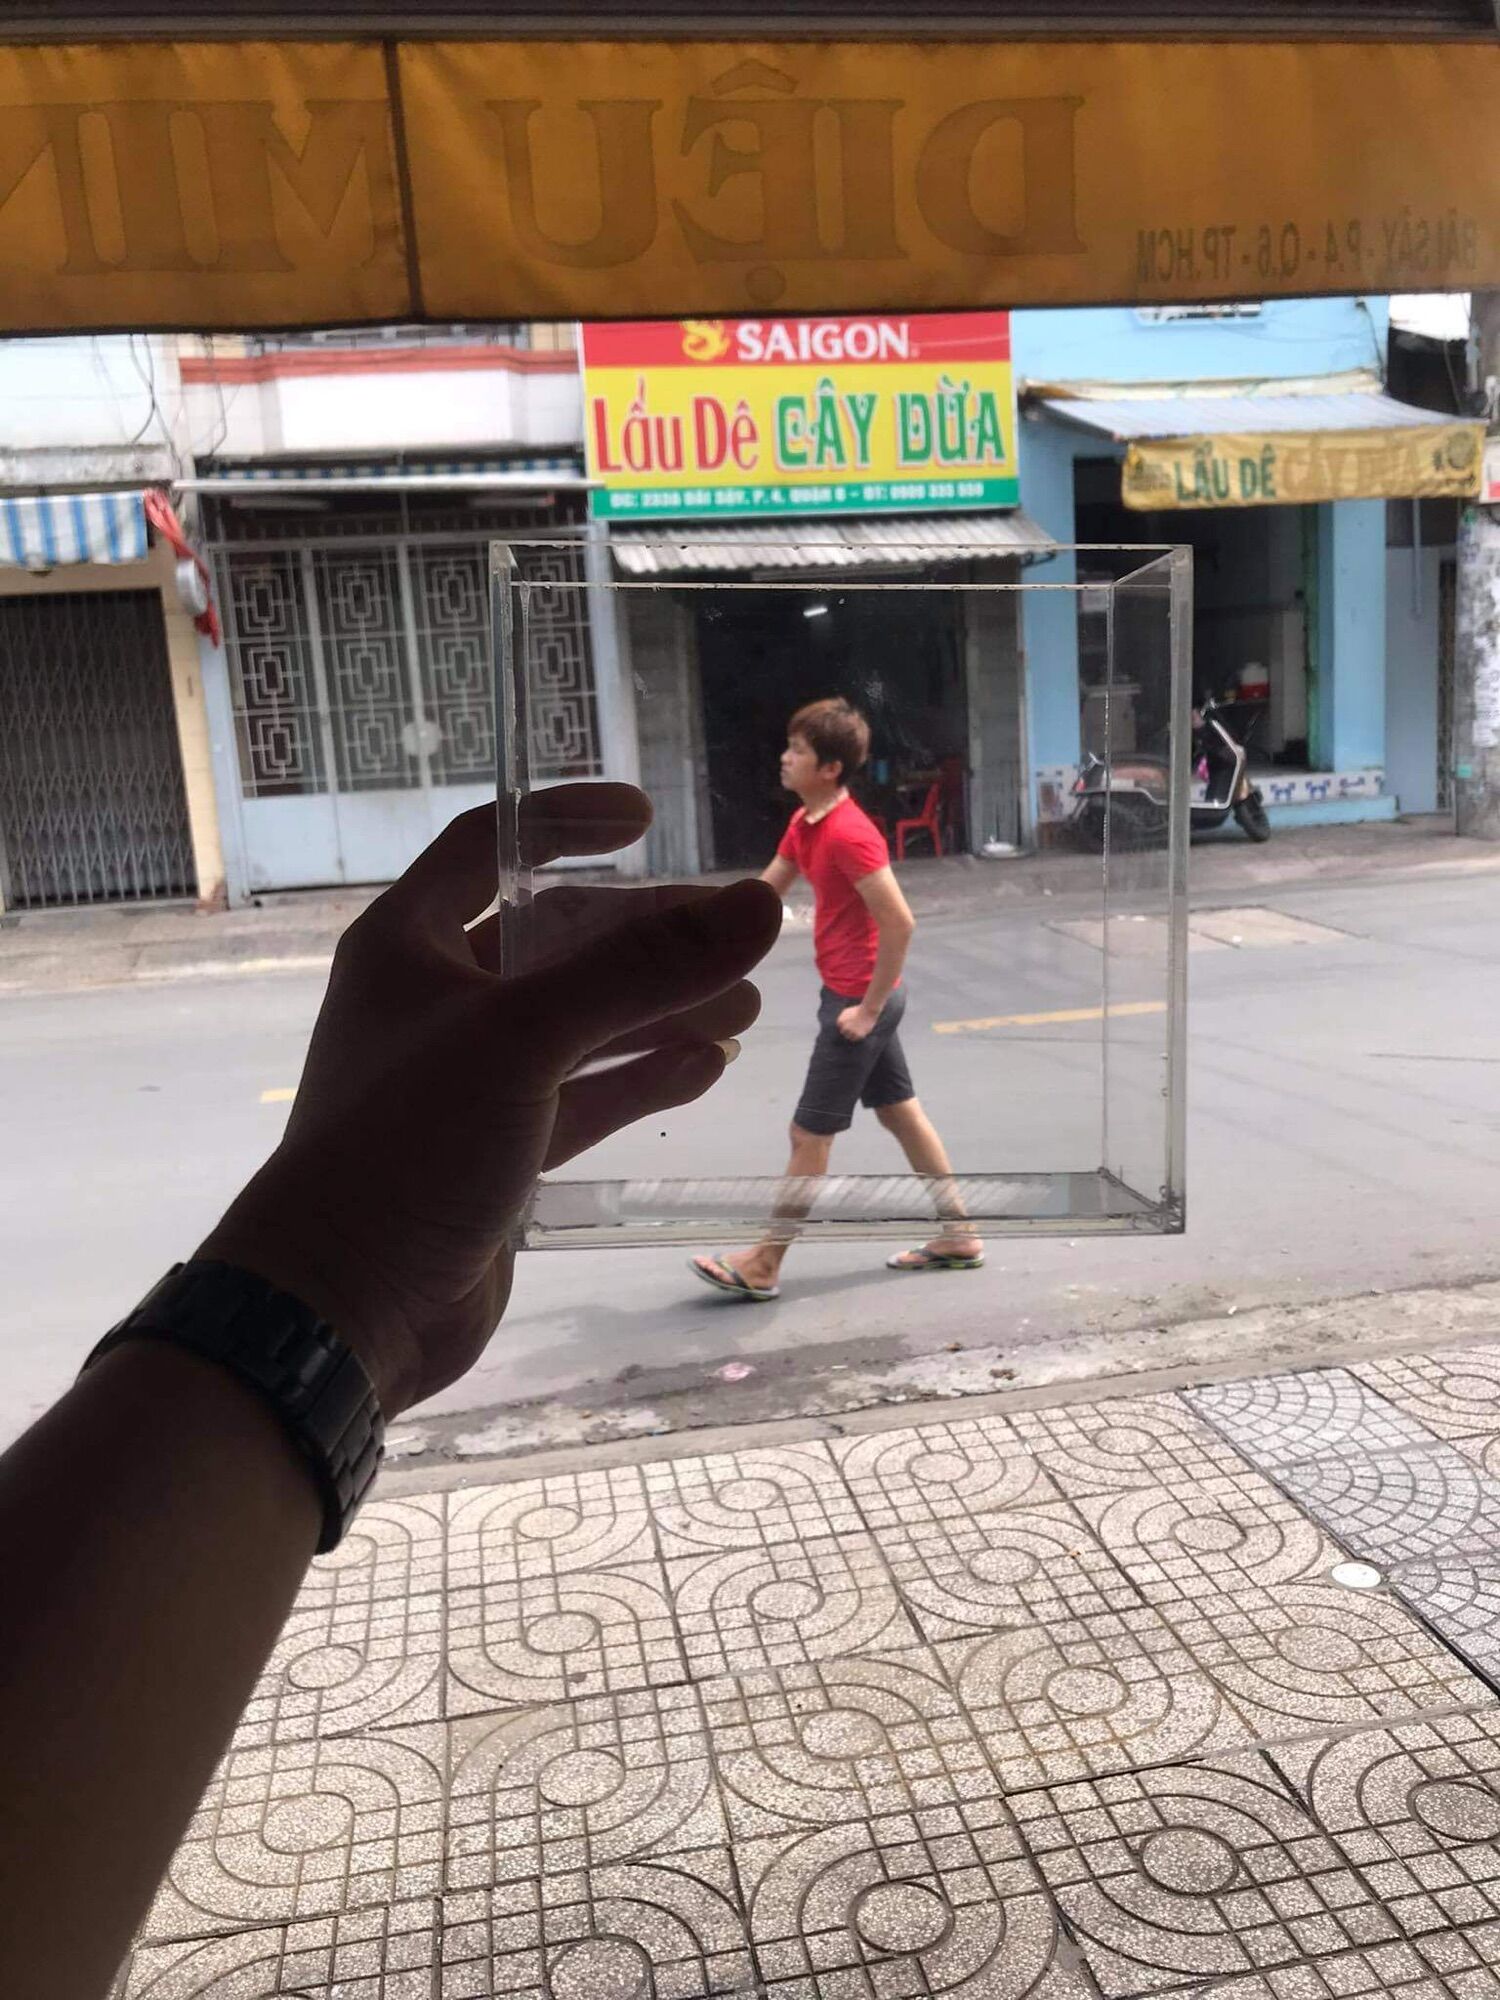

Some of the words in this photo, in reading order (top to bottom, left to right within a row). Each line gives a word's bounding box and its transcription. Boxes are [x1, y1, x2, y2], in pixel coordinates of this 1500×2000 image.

[736, 322, 909, 361] SAIGON
[693, 395, 760, 471] Dê
[775, 375, 878, 470] CÂY
[896, 373, 1006, 468] DỪA
[1239, 443, 1277, 499] DÊ
